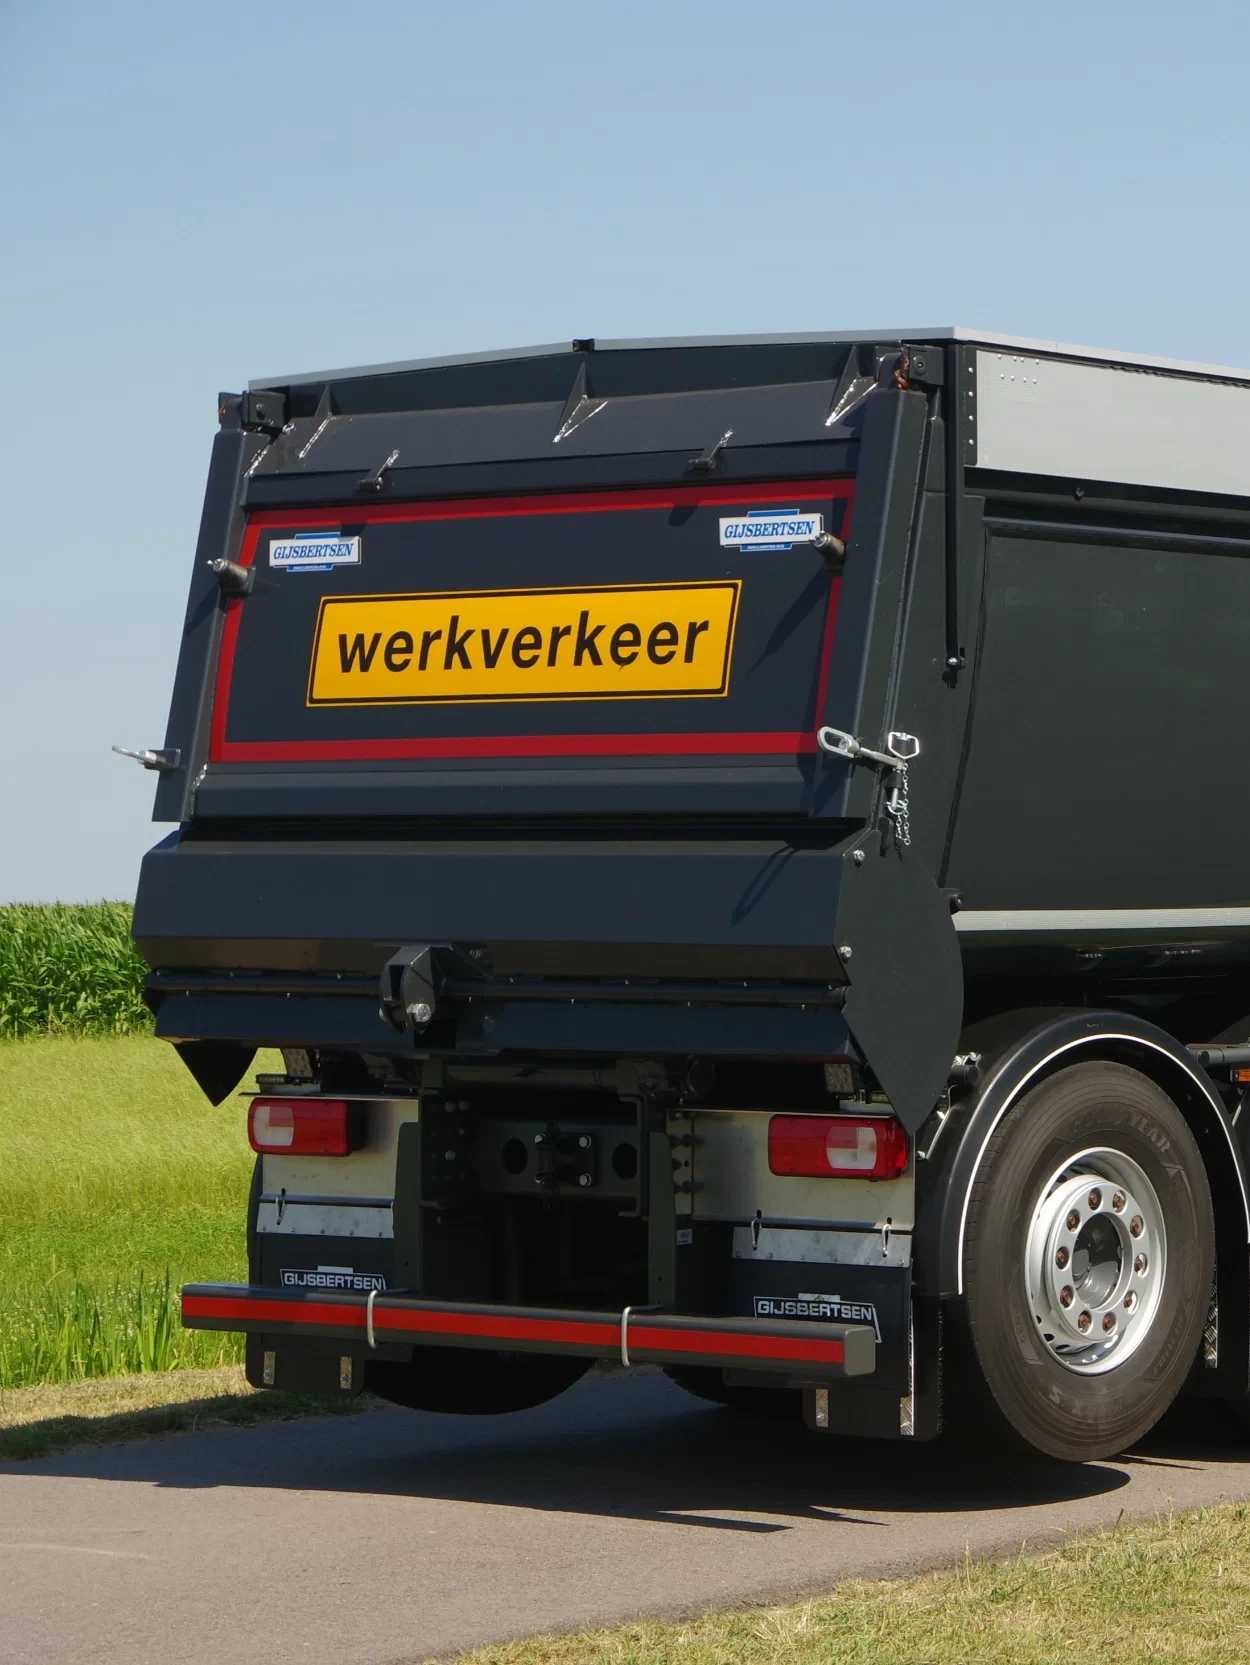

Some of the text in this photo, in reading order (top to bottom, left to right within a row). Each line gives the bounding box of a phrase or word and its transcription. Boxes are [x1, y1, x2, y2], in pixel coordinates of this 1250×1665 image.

[724, 520, 815, 539] GIJSBERTSEN
[273, 543, 354, 559] GIJSBERTSEN
[338, 610, 709, 674] werkverkeer
[283, 1272, 381, 1290] GIJSBERTSEN
[757, 1300, 871, 1320] GIJSBERTSEN
